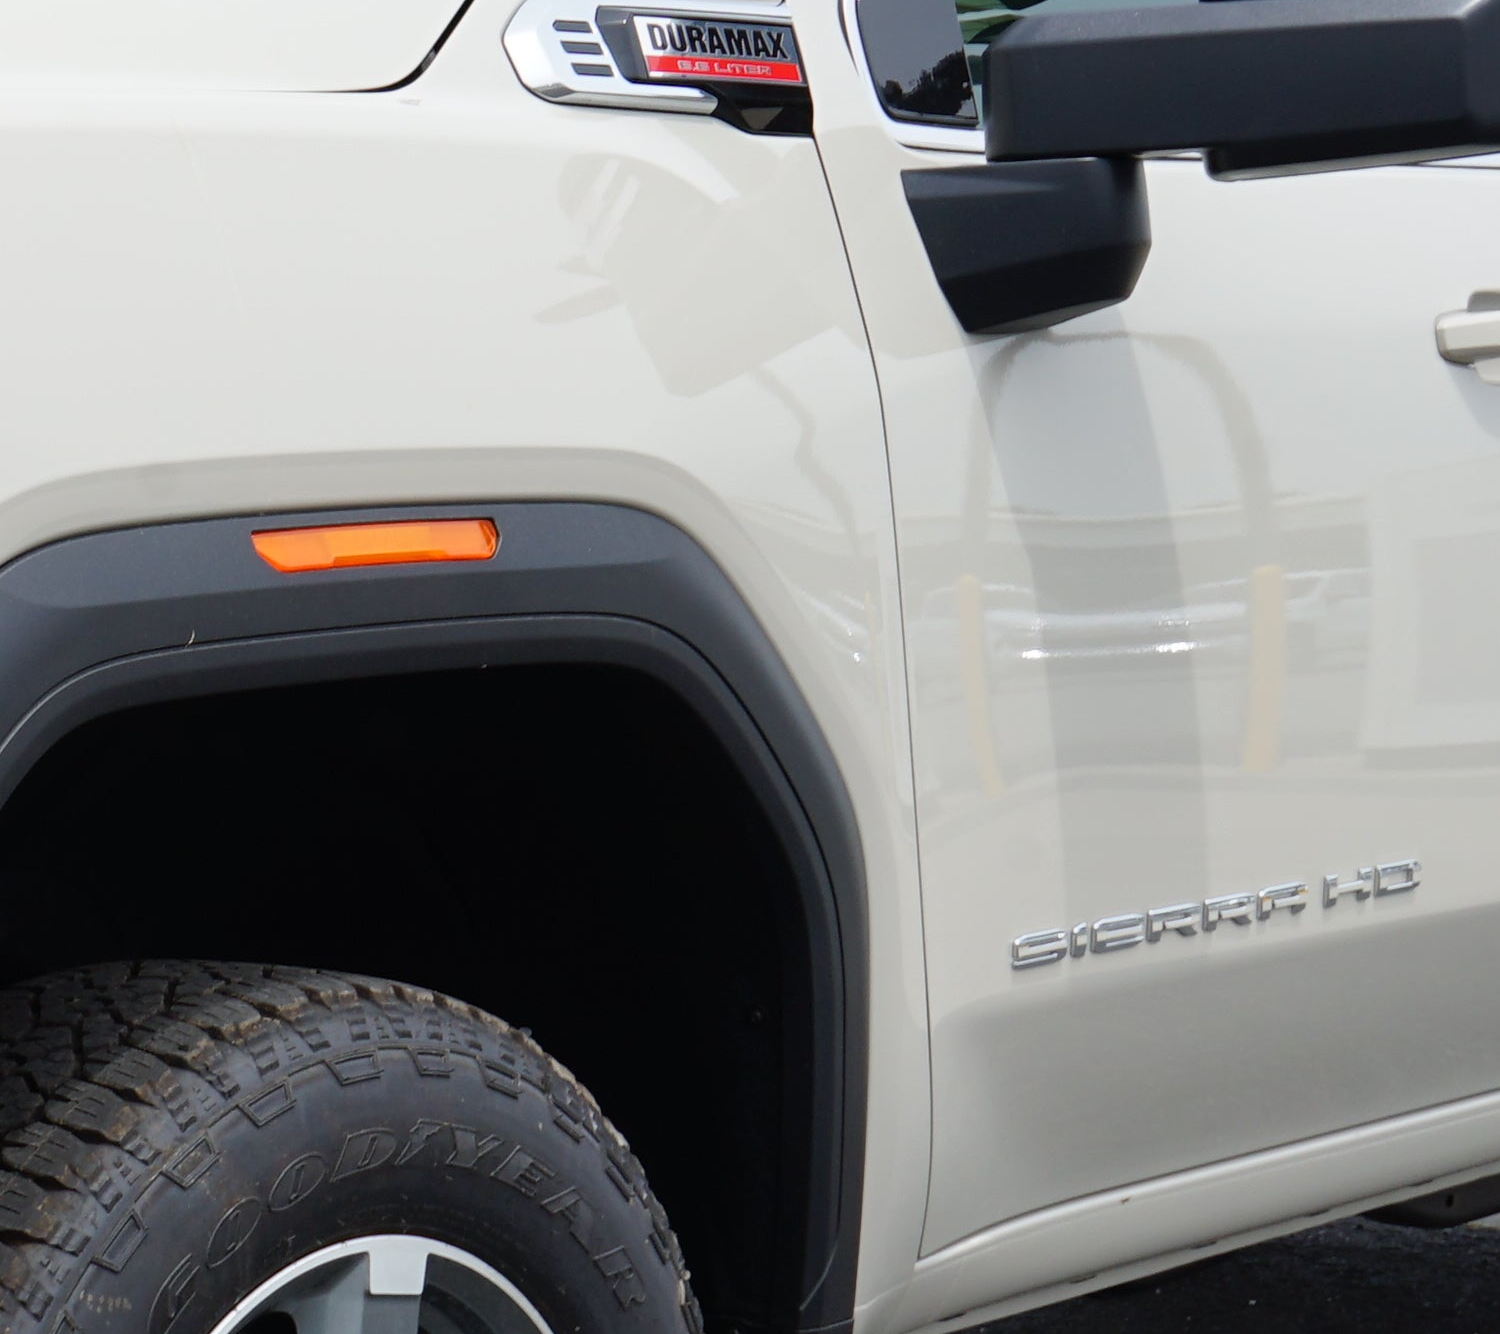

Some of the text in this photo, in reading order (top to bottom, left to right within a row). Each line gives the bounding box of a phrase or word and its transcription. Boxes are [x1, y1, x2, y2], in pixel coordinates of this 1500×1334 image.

[645, 22, 790, 60] DURAMAX
[676, 59, 775, 76] 6.6 LITER
[1011, 857, 1423, 971] SIERRA HD
